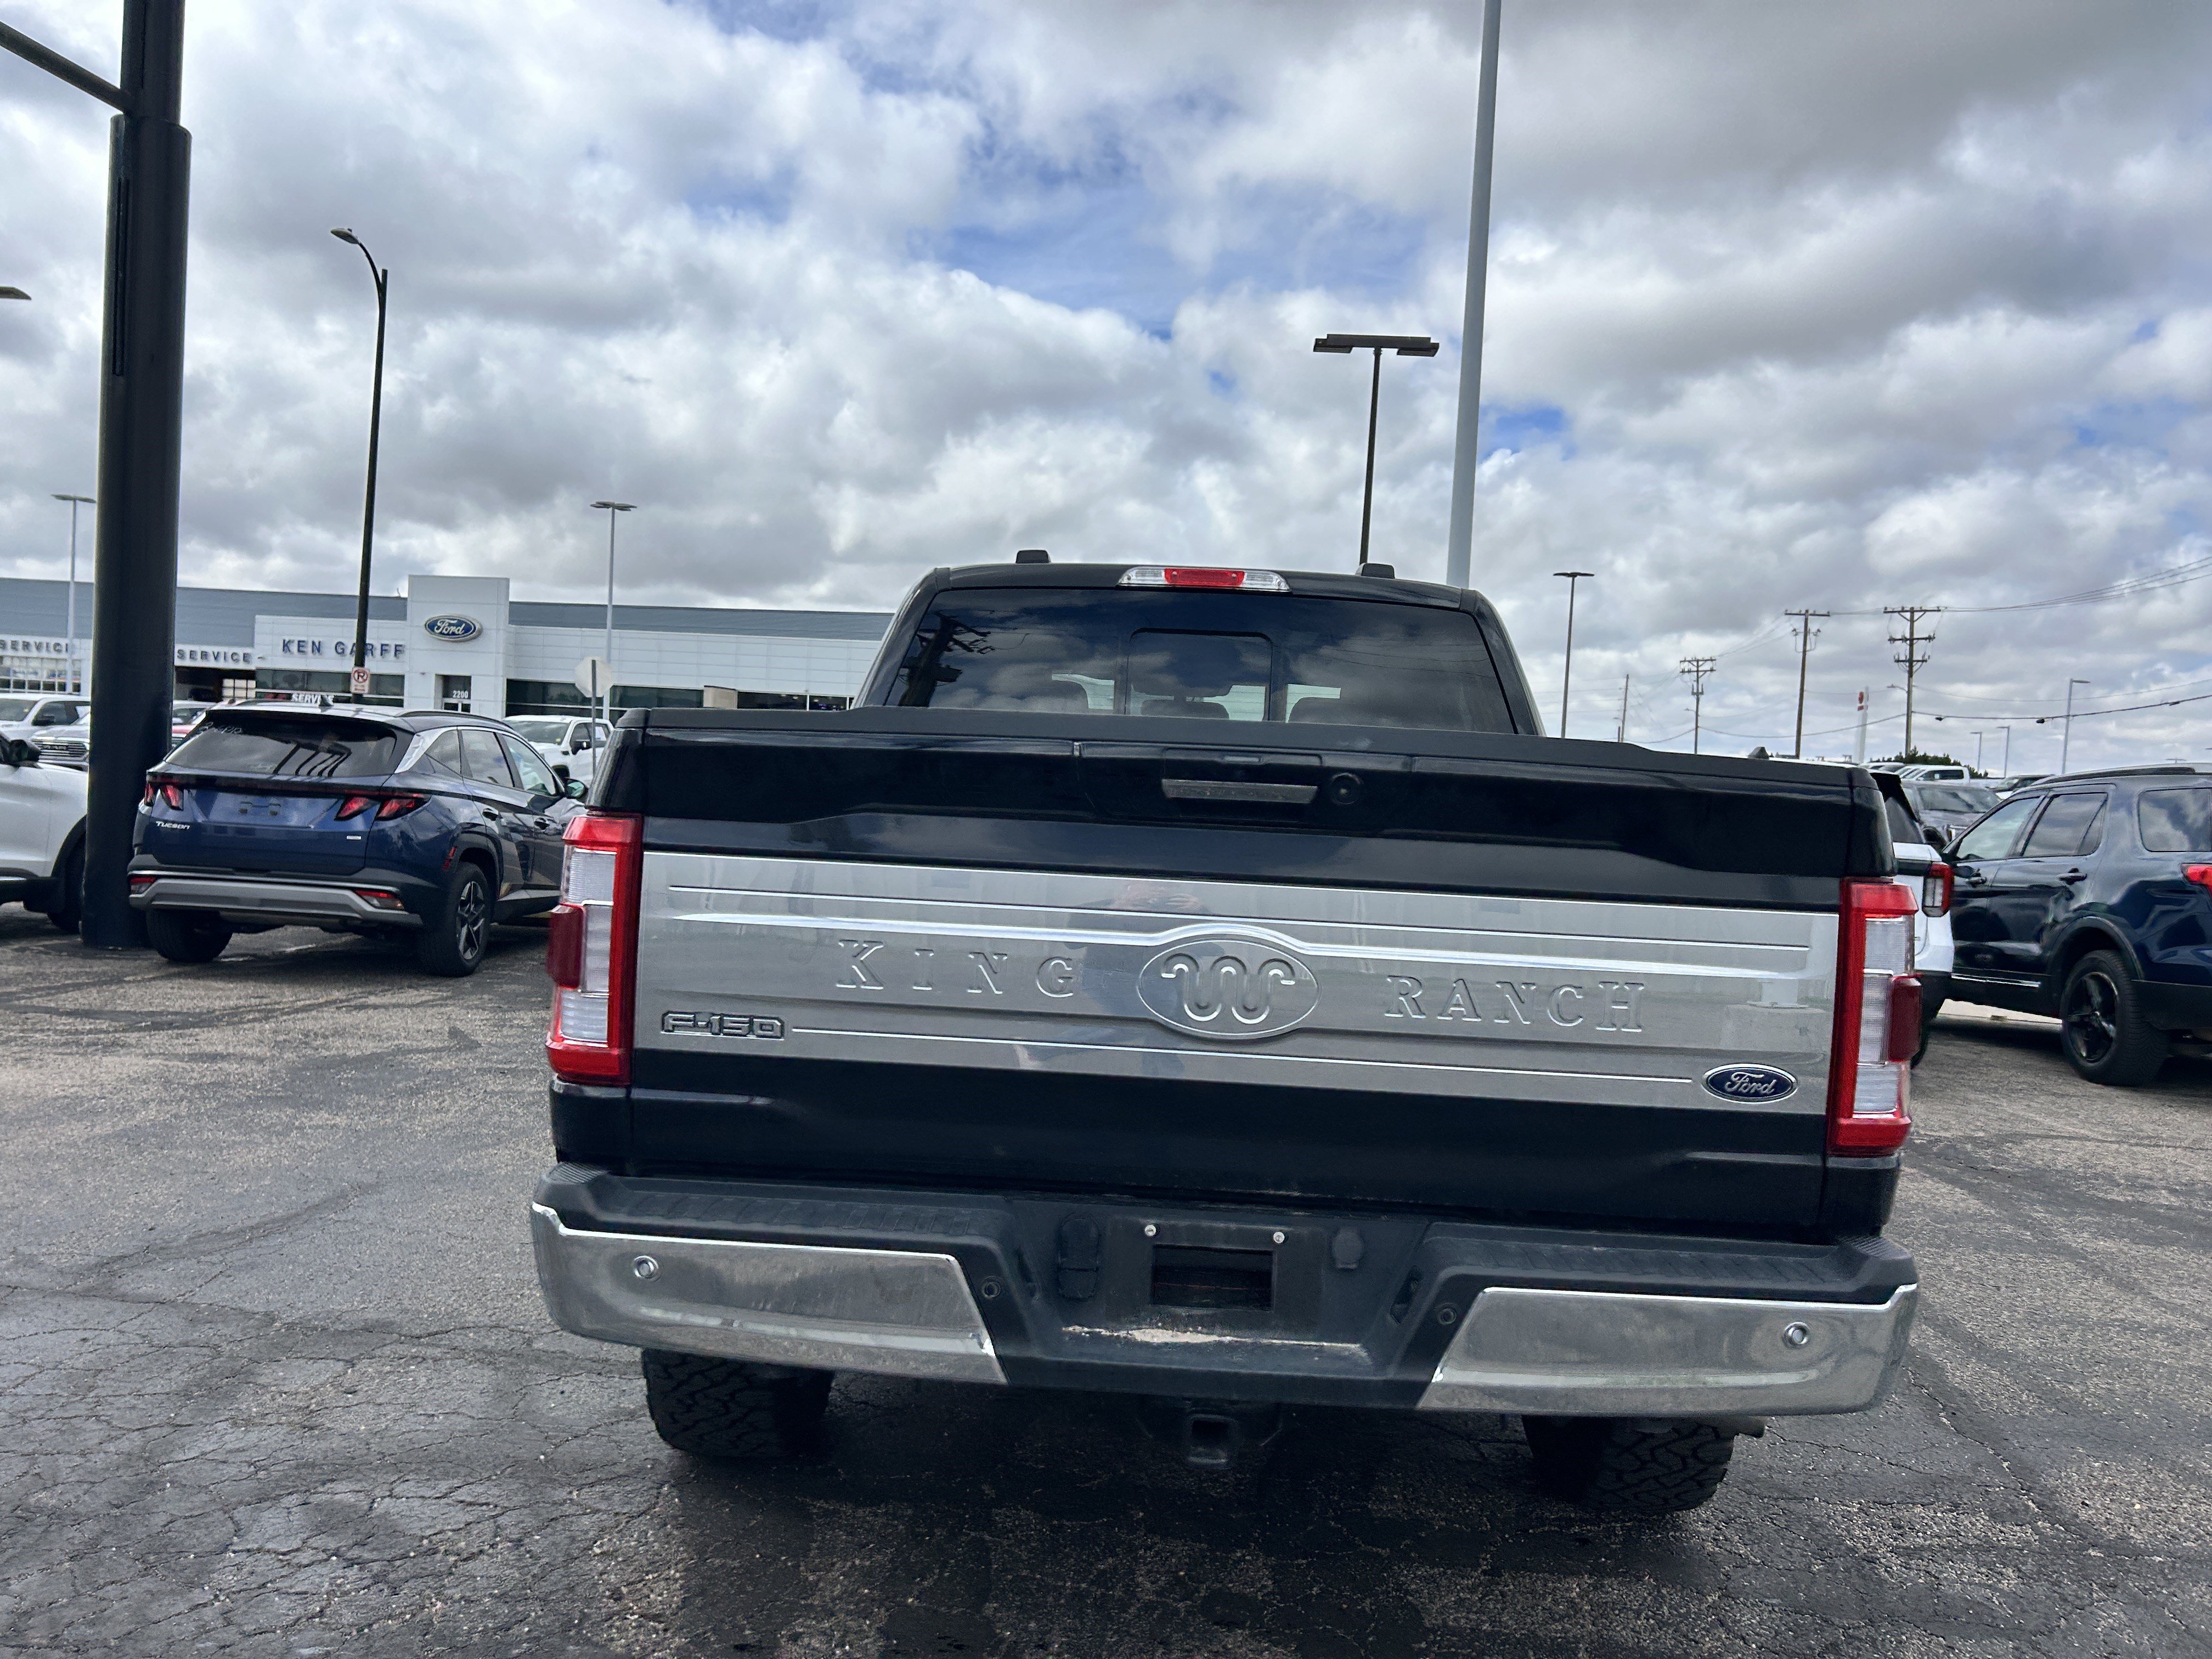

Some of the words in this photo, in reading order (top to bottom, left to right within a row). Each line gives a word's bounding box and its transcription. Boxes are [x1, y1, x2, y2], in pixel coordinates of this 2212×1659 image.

[434, 619, 465, 634] Ford
[282, 639, 321, 654] KEN
[177, 650, 253, 663] SERVICE
[453, 690, 469, 698] 2200
[836, 940, 1074, 998] KING
[1385, 974, 1644, 1032] RANCH
[661, 1011, 786, 1040] F-150
[1724, 1071, 1777, 1094] Ford
